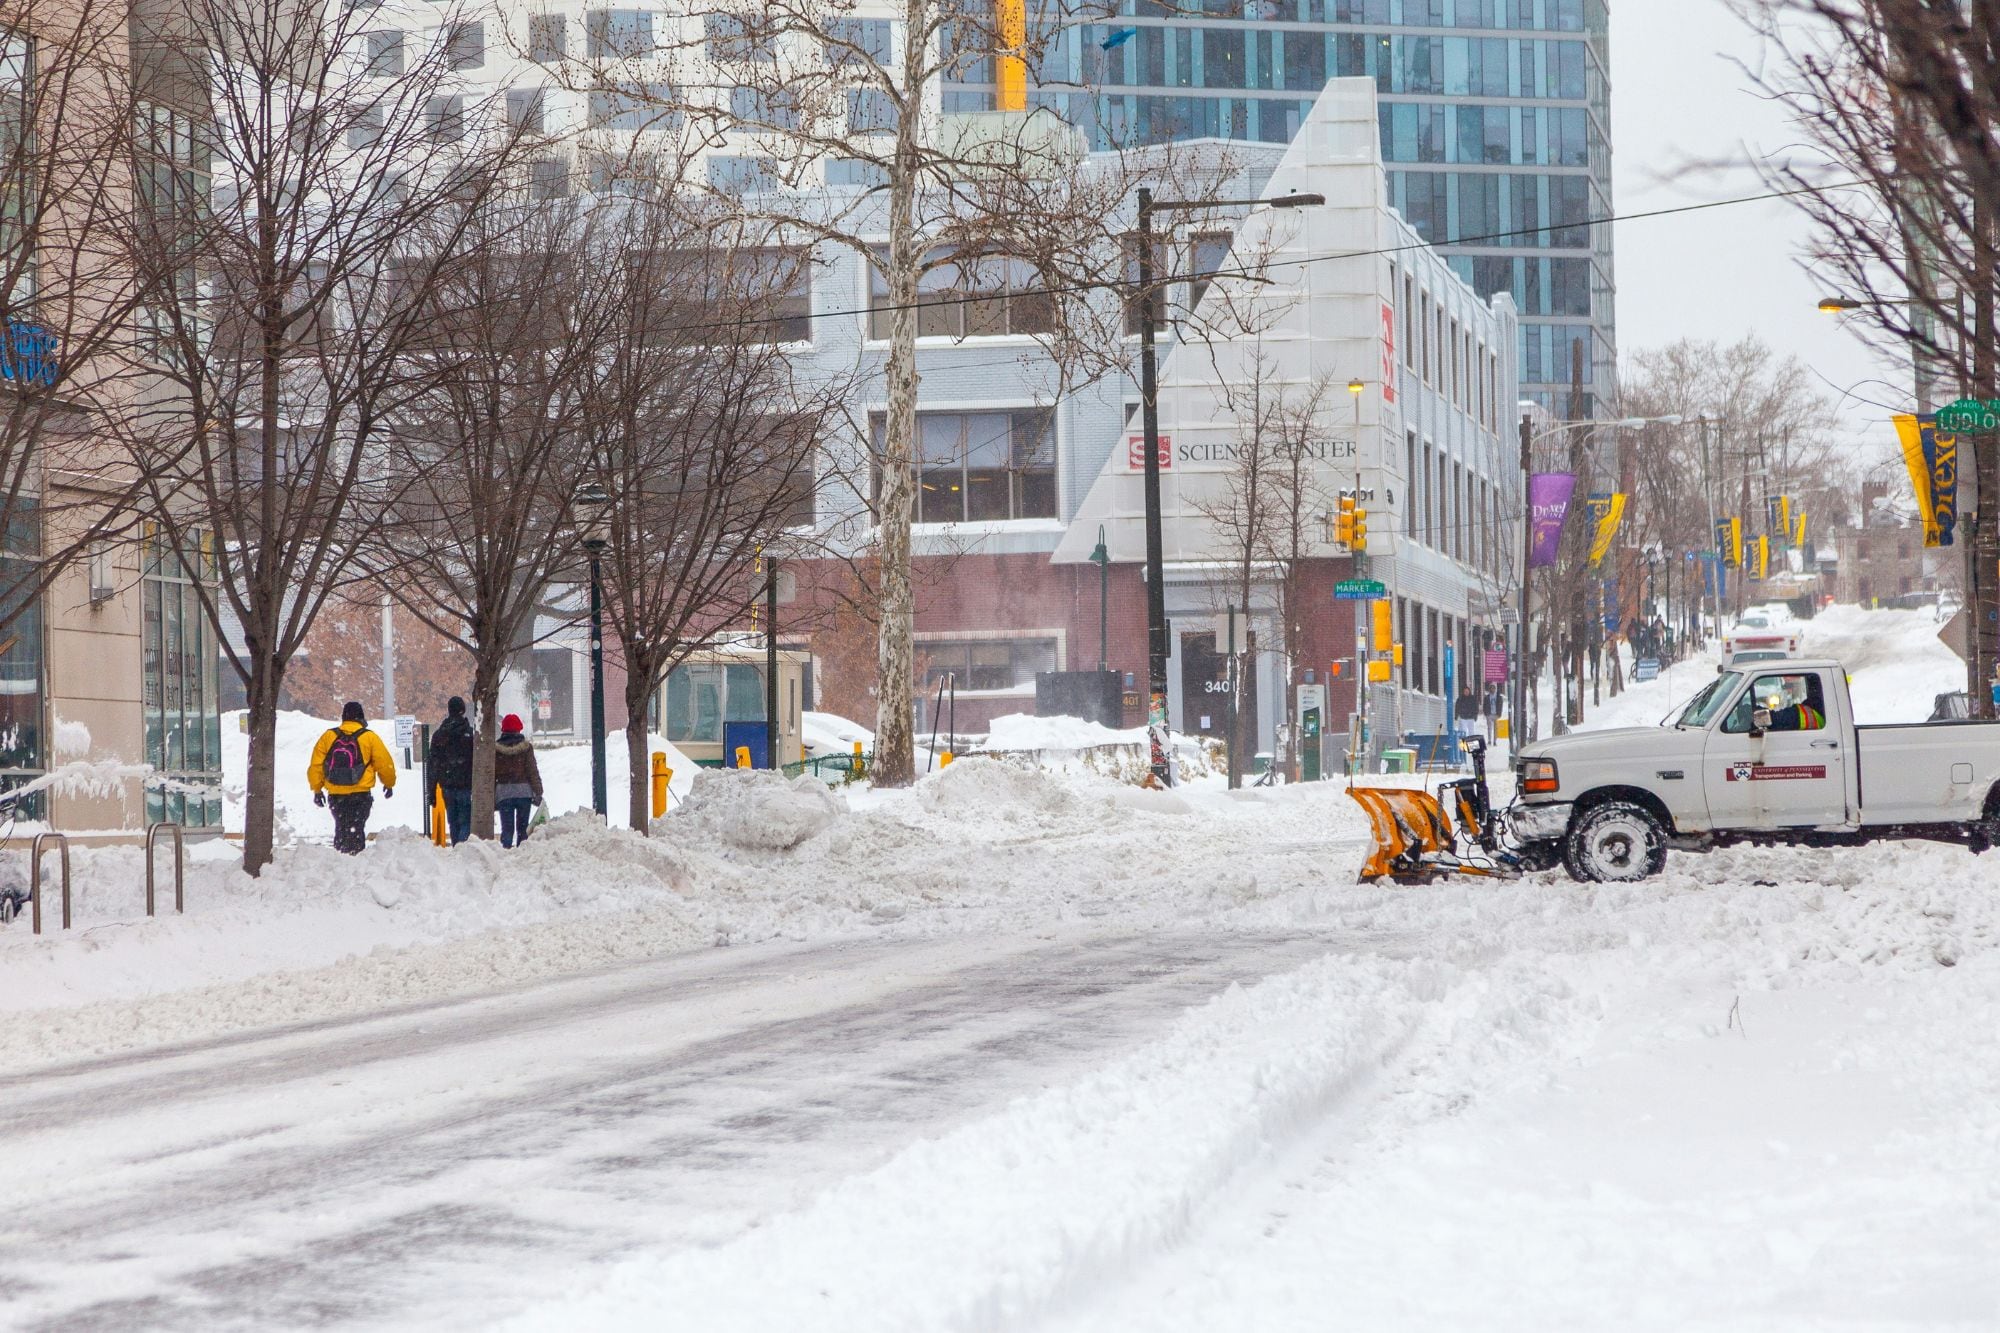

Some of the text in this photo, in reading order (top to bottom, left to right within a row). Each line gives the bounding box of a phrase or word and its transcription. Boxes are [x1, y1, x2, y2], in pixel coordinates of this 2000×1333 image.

[1940, 413, 2000, 430] LUDLO
[1273, 441, 1358, 459] CENTER
[1336, 584, 1370, 593] MARKET
